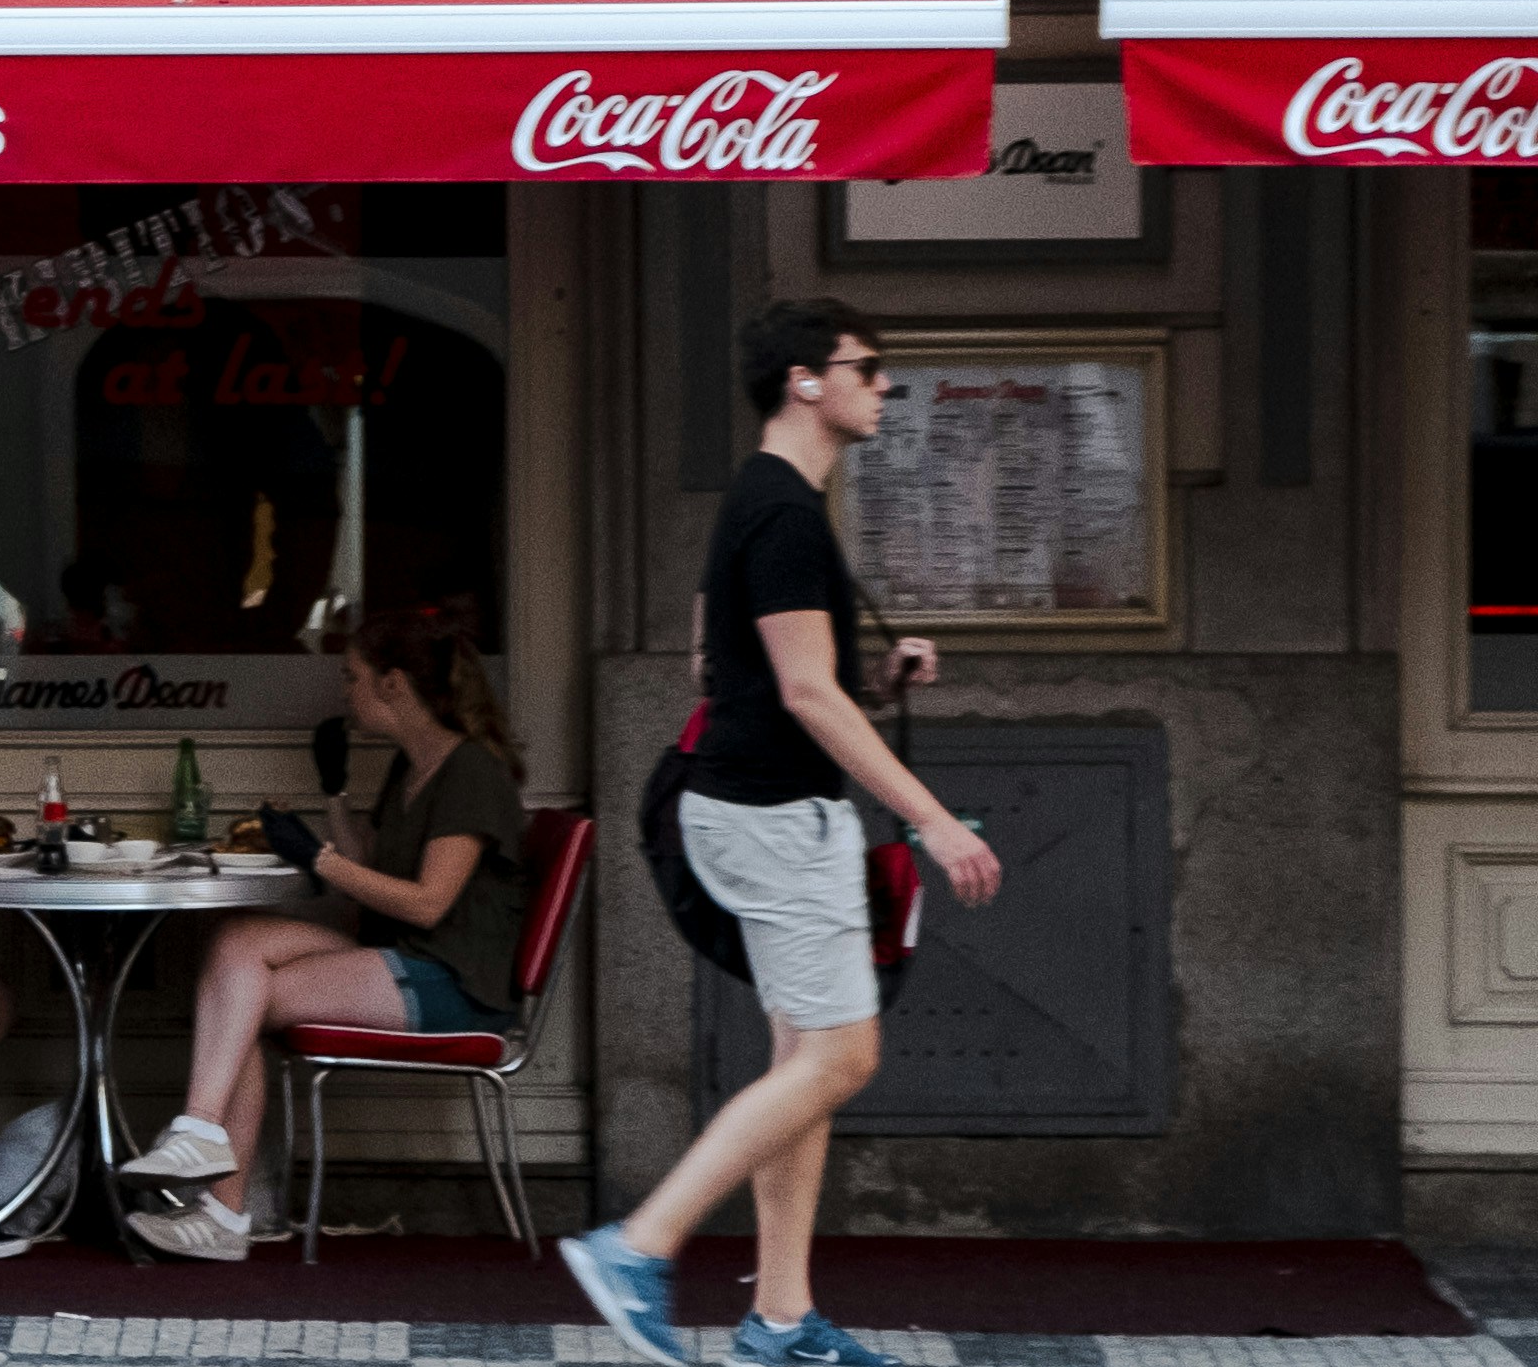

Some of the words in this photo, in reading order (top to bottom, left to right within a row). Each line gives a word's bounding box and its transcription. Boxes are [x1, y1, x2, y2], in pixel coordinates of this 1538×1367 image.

[511, 70, 840, 171] Coca-Cola
[23, 257, 210, 331] ends
[102, 360, 191, 408] at
[115, 664, 228, 710] Dean
